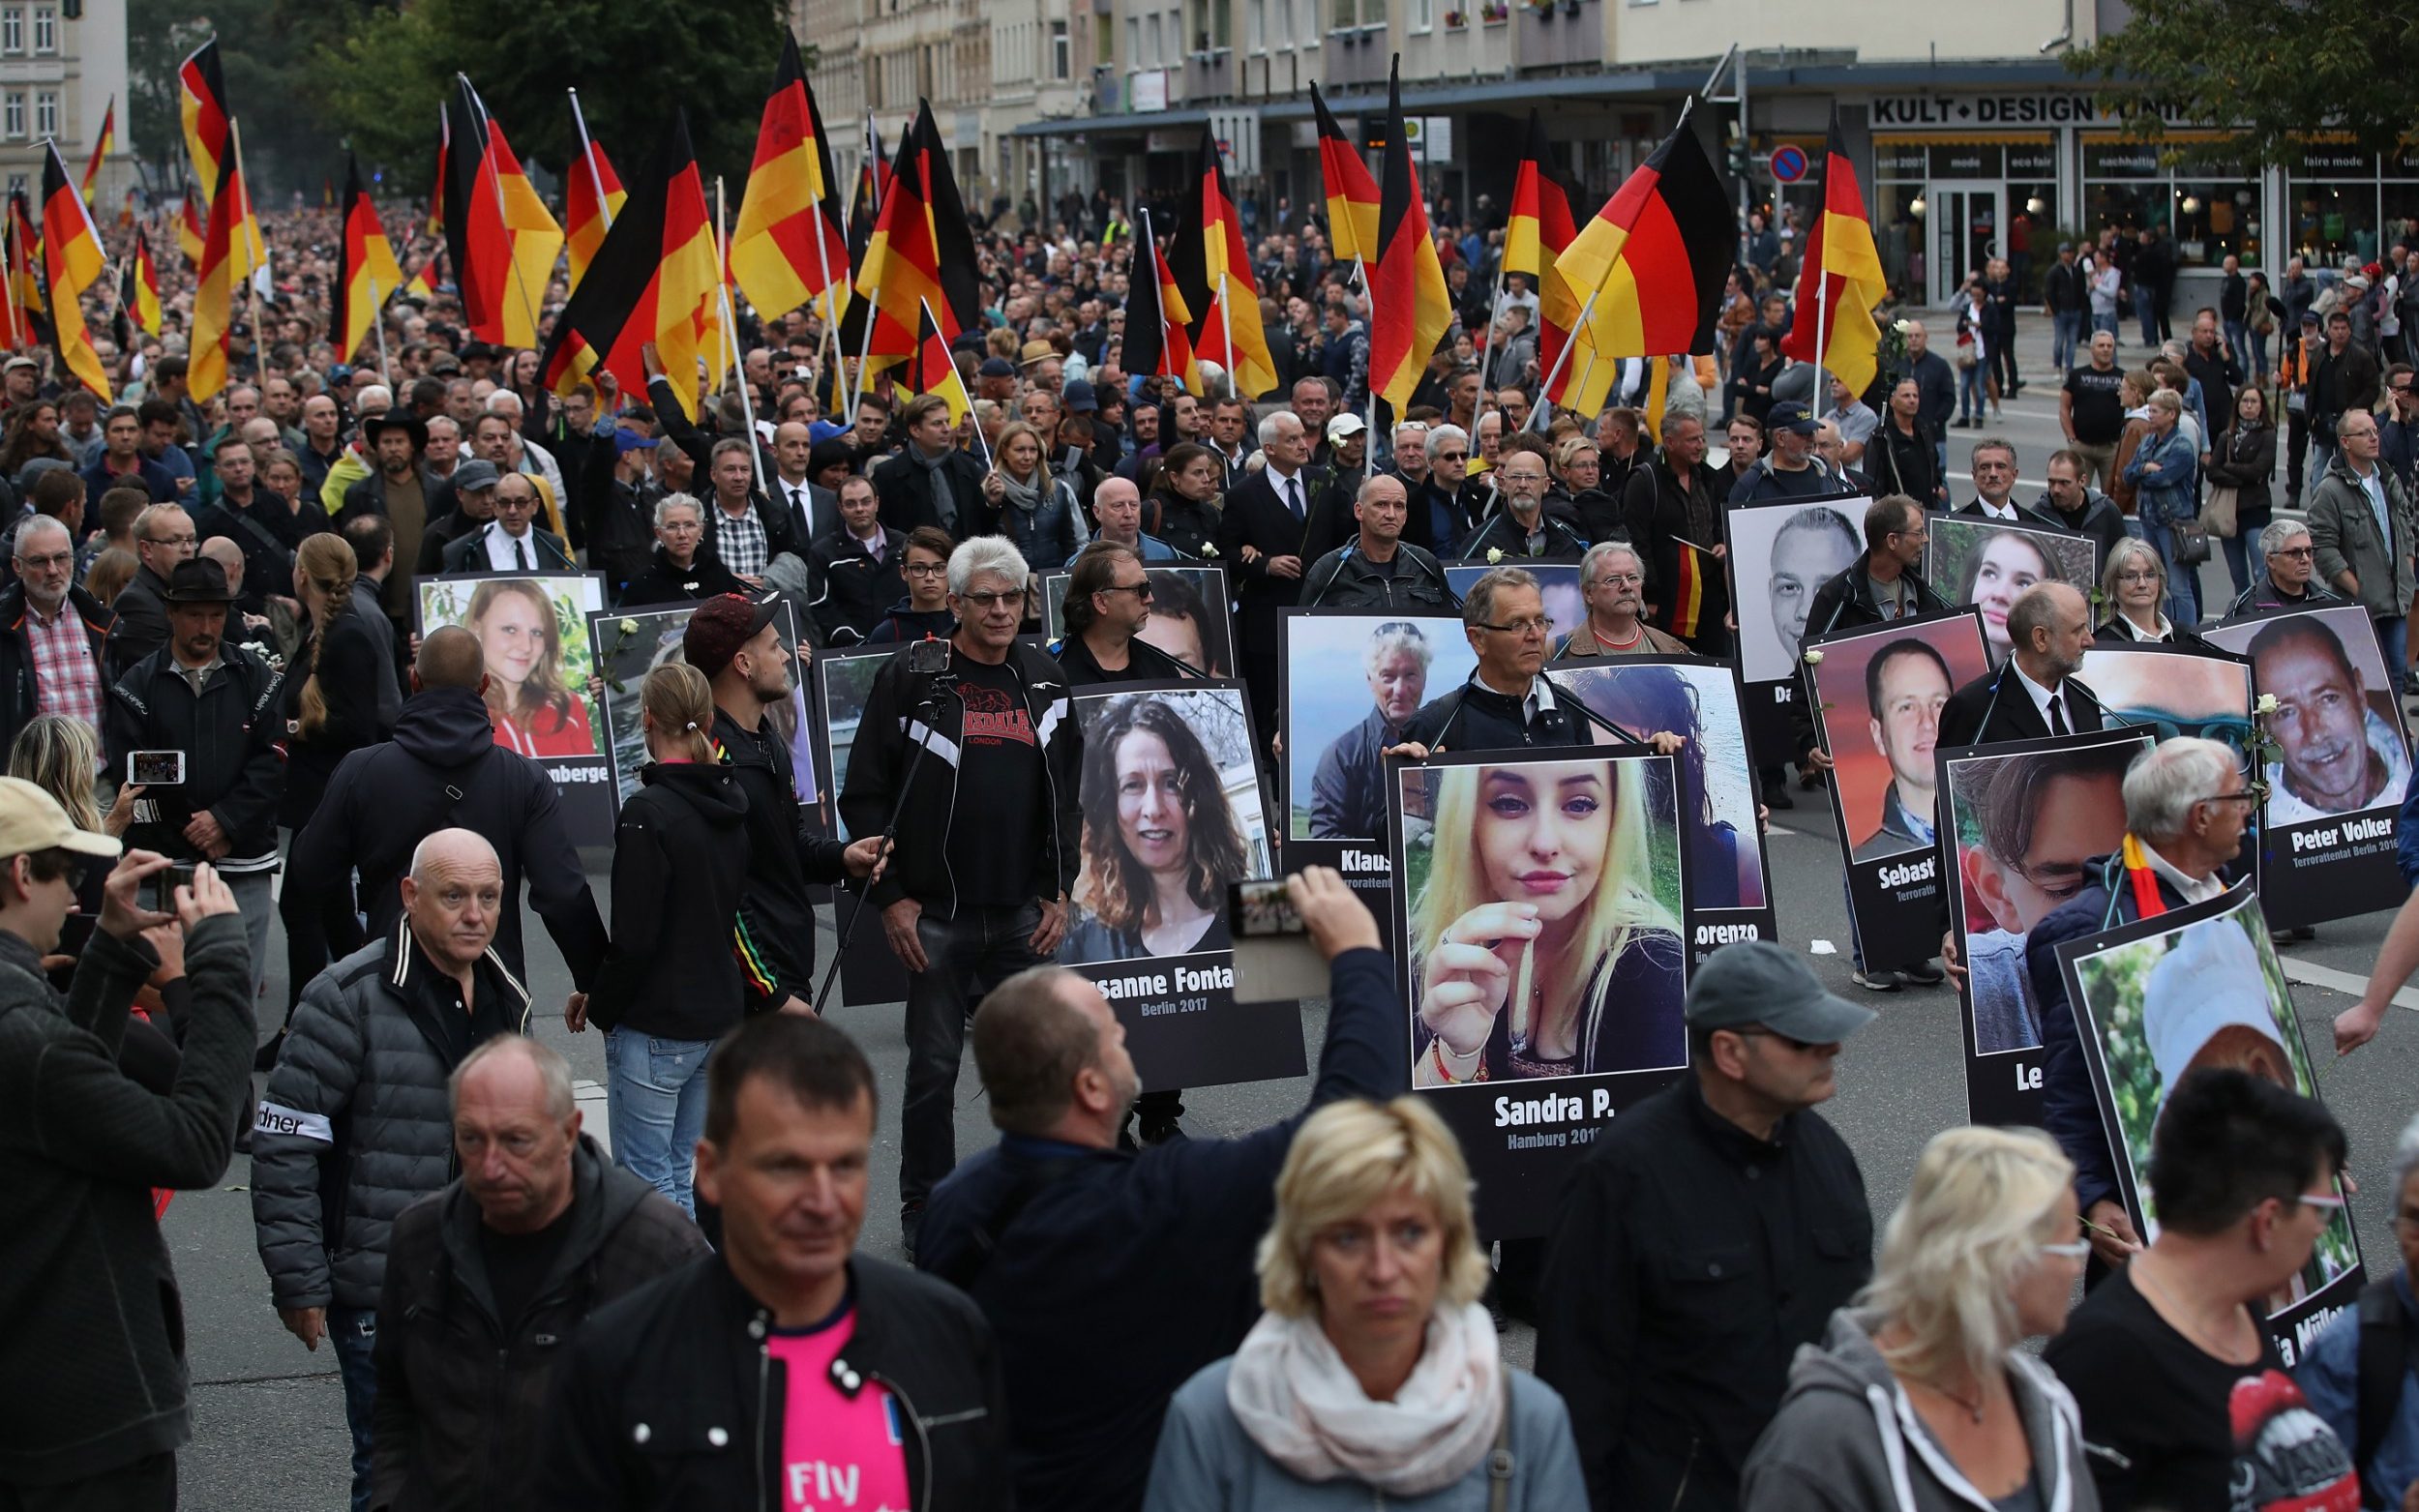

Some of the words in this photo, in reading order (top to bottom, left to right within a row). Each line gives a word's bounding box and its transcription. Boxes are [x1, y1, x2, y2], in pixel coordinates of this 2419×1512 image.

[1875, 100, 1953, 122] KULT
[1978, 99, 2094, 122] DESIGN
[1951, 157, 1981, 168] mode
[2012, 158, 2031, 167] eco
[2033, 155, 2051, 167] fair
[2099, 155, 2156, 169] nachhaltig
[2304, 156, 2329, 166] faire
[2333, 156, 2363, 166] mode
[2291, 828, 2338, 852] Peter
[2342, 817, 2392, 842] Volker
[1341, 849, 1391, 872] Klaus
[2293, 847, 2351, 869] Terrorattentat
[2352, 843, 2377, 856] Berlin
[2378, 838, 2399, 851] 2016
[1141, 1001, 1177, 1016] Berlin
[1180, 997, 1208, 1013] 2017
[2016, 1062, 2043, 1091] Le
[1495, 1092, 1583, 1127] Sandra
[1593, 1088, 1615, 1118] P.
[255, 1105, 304, 1135] dner
[1508, 1132, 1567, 1150] Hamburg
[788, 1460, 860, 1506] Fly
